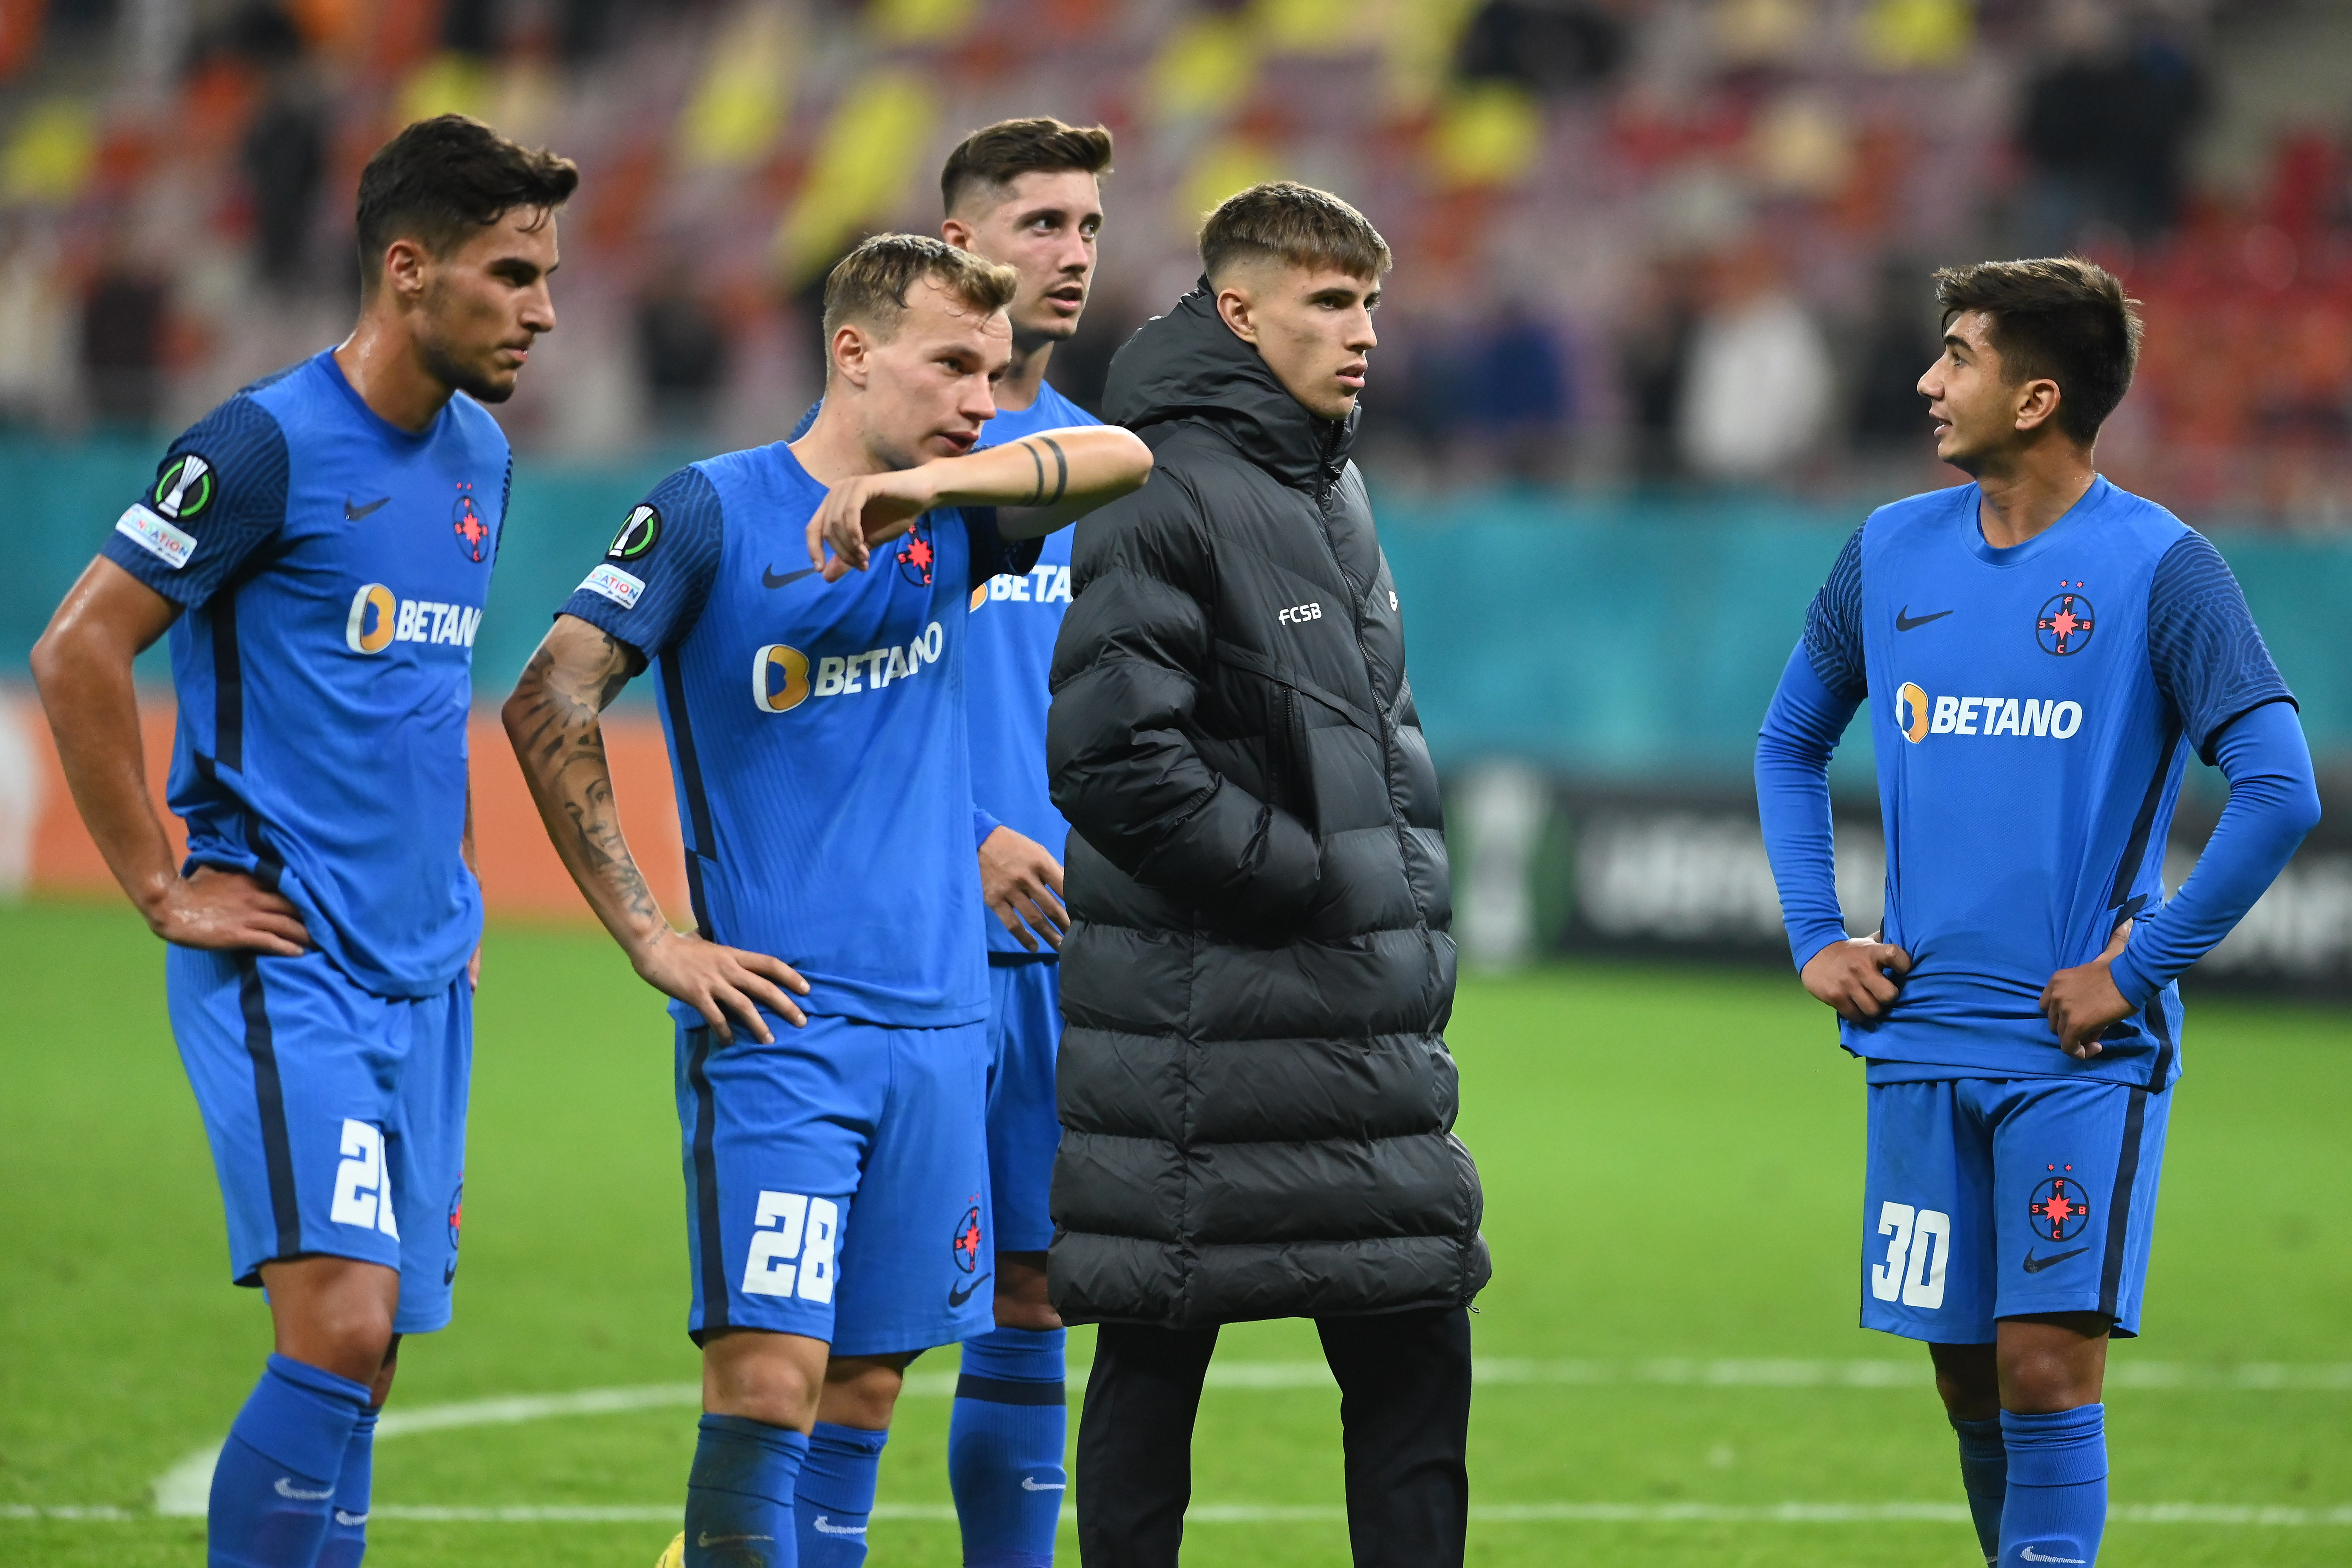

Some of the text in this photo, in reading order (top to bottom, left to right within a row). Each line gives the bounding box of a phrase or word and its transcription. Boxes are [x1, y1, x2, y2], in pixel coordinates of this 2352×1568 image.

[991, 565, 1074, 603] BETA
[2064, 596, 2073, 605] F
[1278, 602, 1322, 625] FCSB
[395, 599, 484, 648] BETAN
[2039, 620, 2047, 628] S
[2082, 621, 2091, 630] B
[2057, 645, 2065, 653] C
[814, 621, 943, 697] BETANO
[1930, 696, 2083, 739] BETANO
[2055, 1180, 2064, 1188] F
[2032, 1204, 2039, 1213] S
[2079, 1206, 2087, 1215] B
[2053, 1230, 2061, 1239] C
[742, 1190, 838, 1304] 28
[1872, 1201, 1950, 1309] 30
